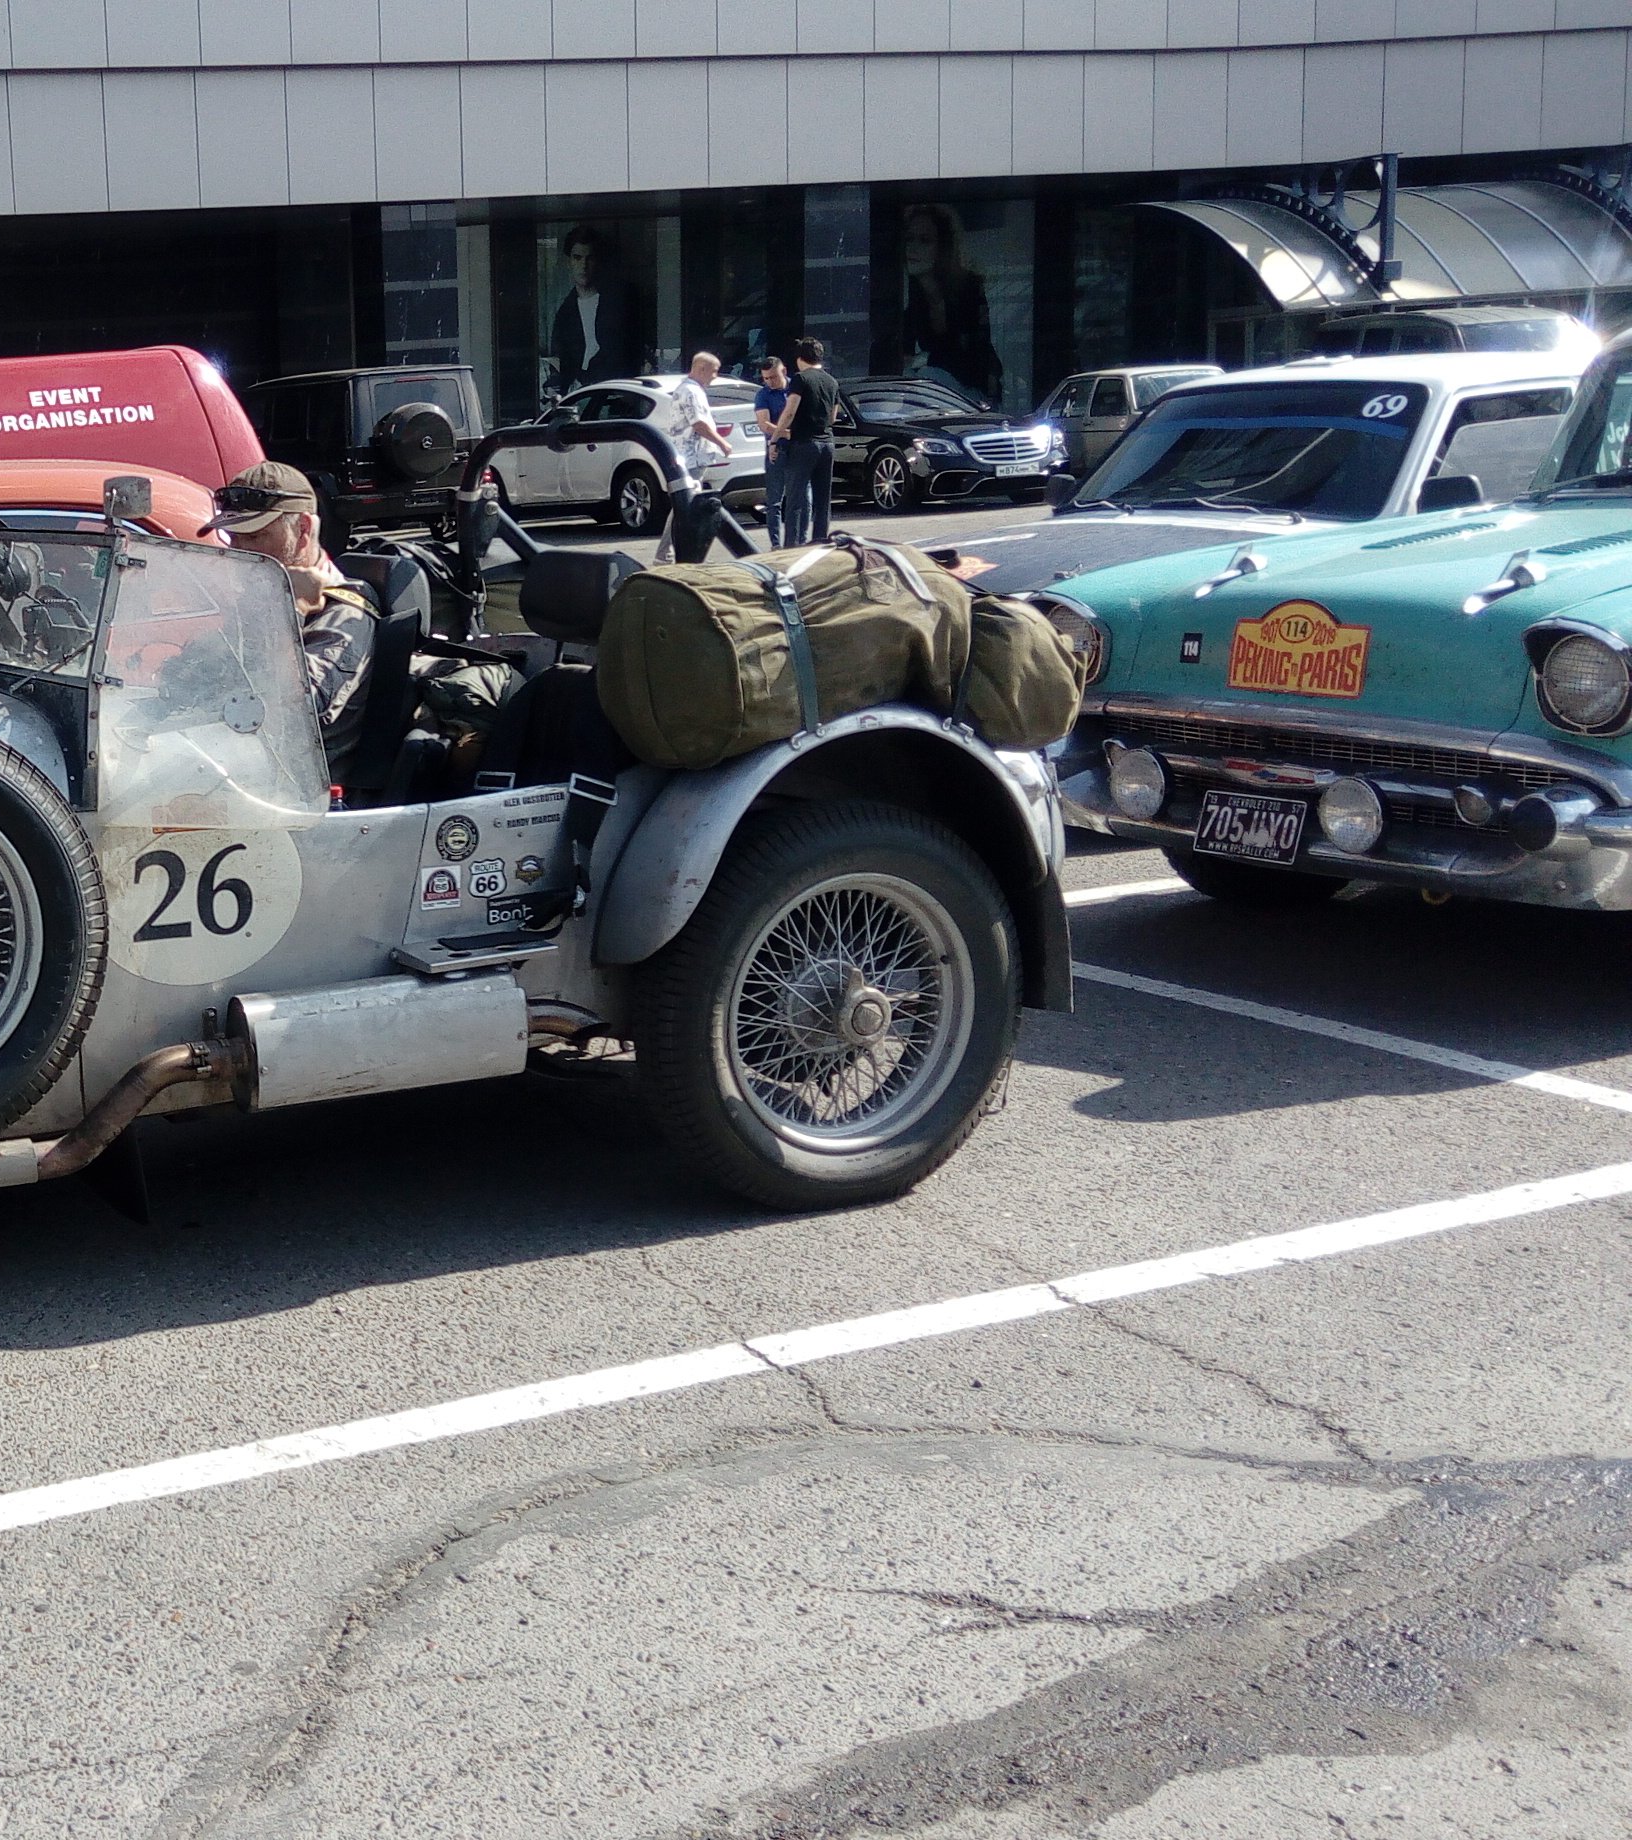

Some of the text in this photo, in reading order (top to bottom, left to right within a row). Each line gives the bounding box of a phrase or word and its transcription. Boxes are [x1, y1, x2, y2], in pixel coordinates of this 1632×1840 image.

[29, 386, 102, 407] EVENT
[1362, 394, 1408, 418] 69
[1286, 620, 1308, 637] 114
[1232, 634, 1292, 686] PEKING
[1297, 643, 1362, 692] PARIS
[474, 862, 499, 872] ROUTE
[133, 843, 253, 942] 26
[475, 875, 499, 893] 66
